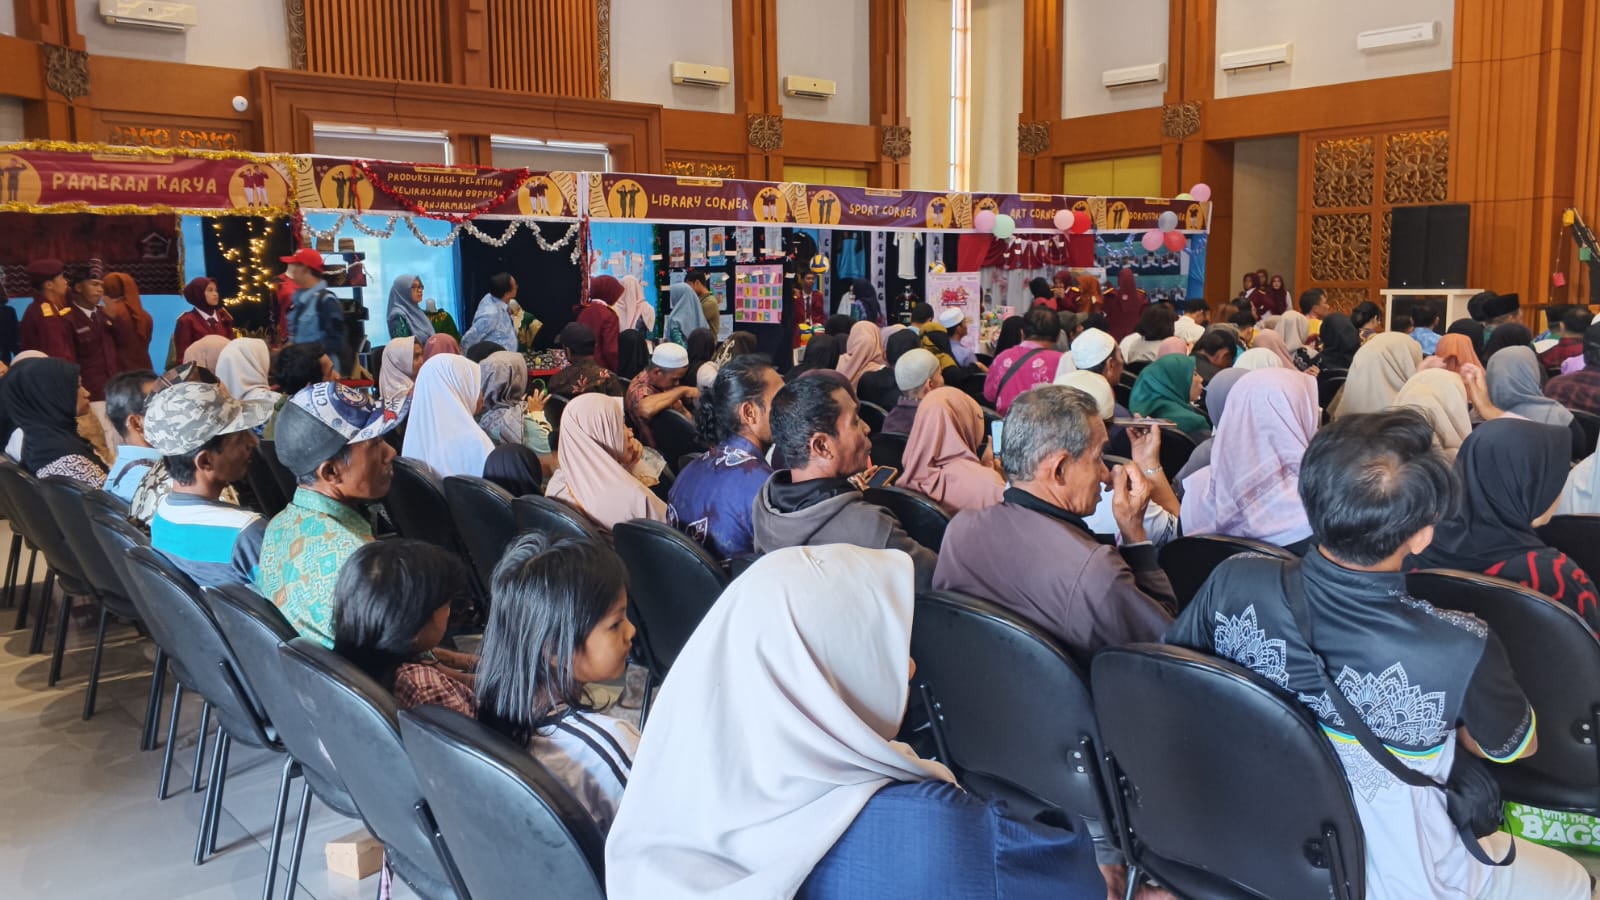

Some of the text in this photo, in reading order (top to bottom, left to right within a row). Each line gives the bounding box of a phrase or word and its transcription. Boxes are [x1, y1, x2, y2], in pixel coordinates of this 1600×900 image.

[52, 173, 217, 194] PAMERAN KARYA
[388, 173, 503, 187] PRODUKSI HASIL PELATIHAN
[393, 186, 497, 199] KEWIRAUSAHAAN BBPPKS
[417, 200, 476, 210] BANJARMASIN
[651, 193, 749, 211] LIBRARY CORNER
[849, 203, 918, 219] SPORT CORNER
[1010, 208, 1057, 220] ART CORNE
[1543, 809, 1566, 822] WITH
